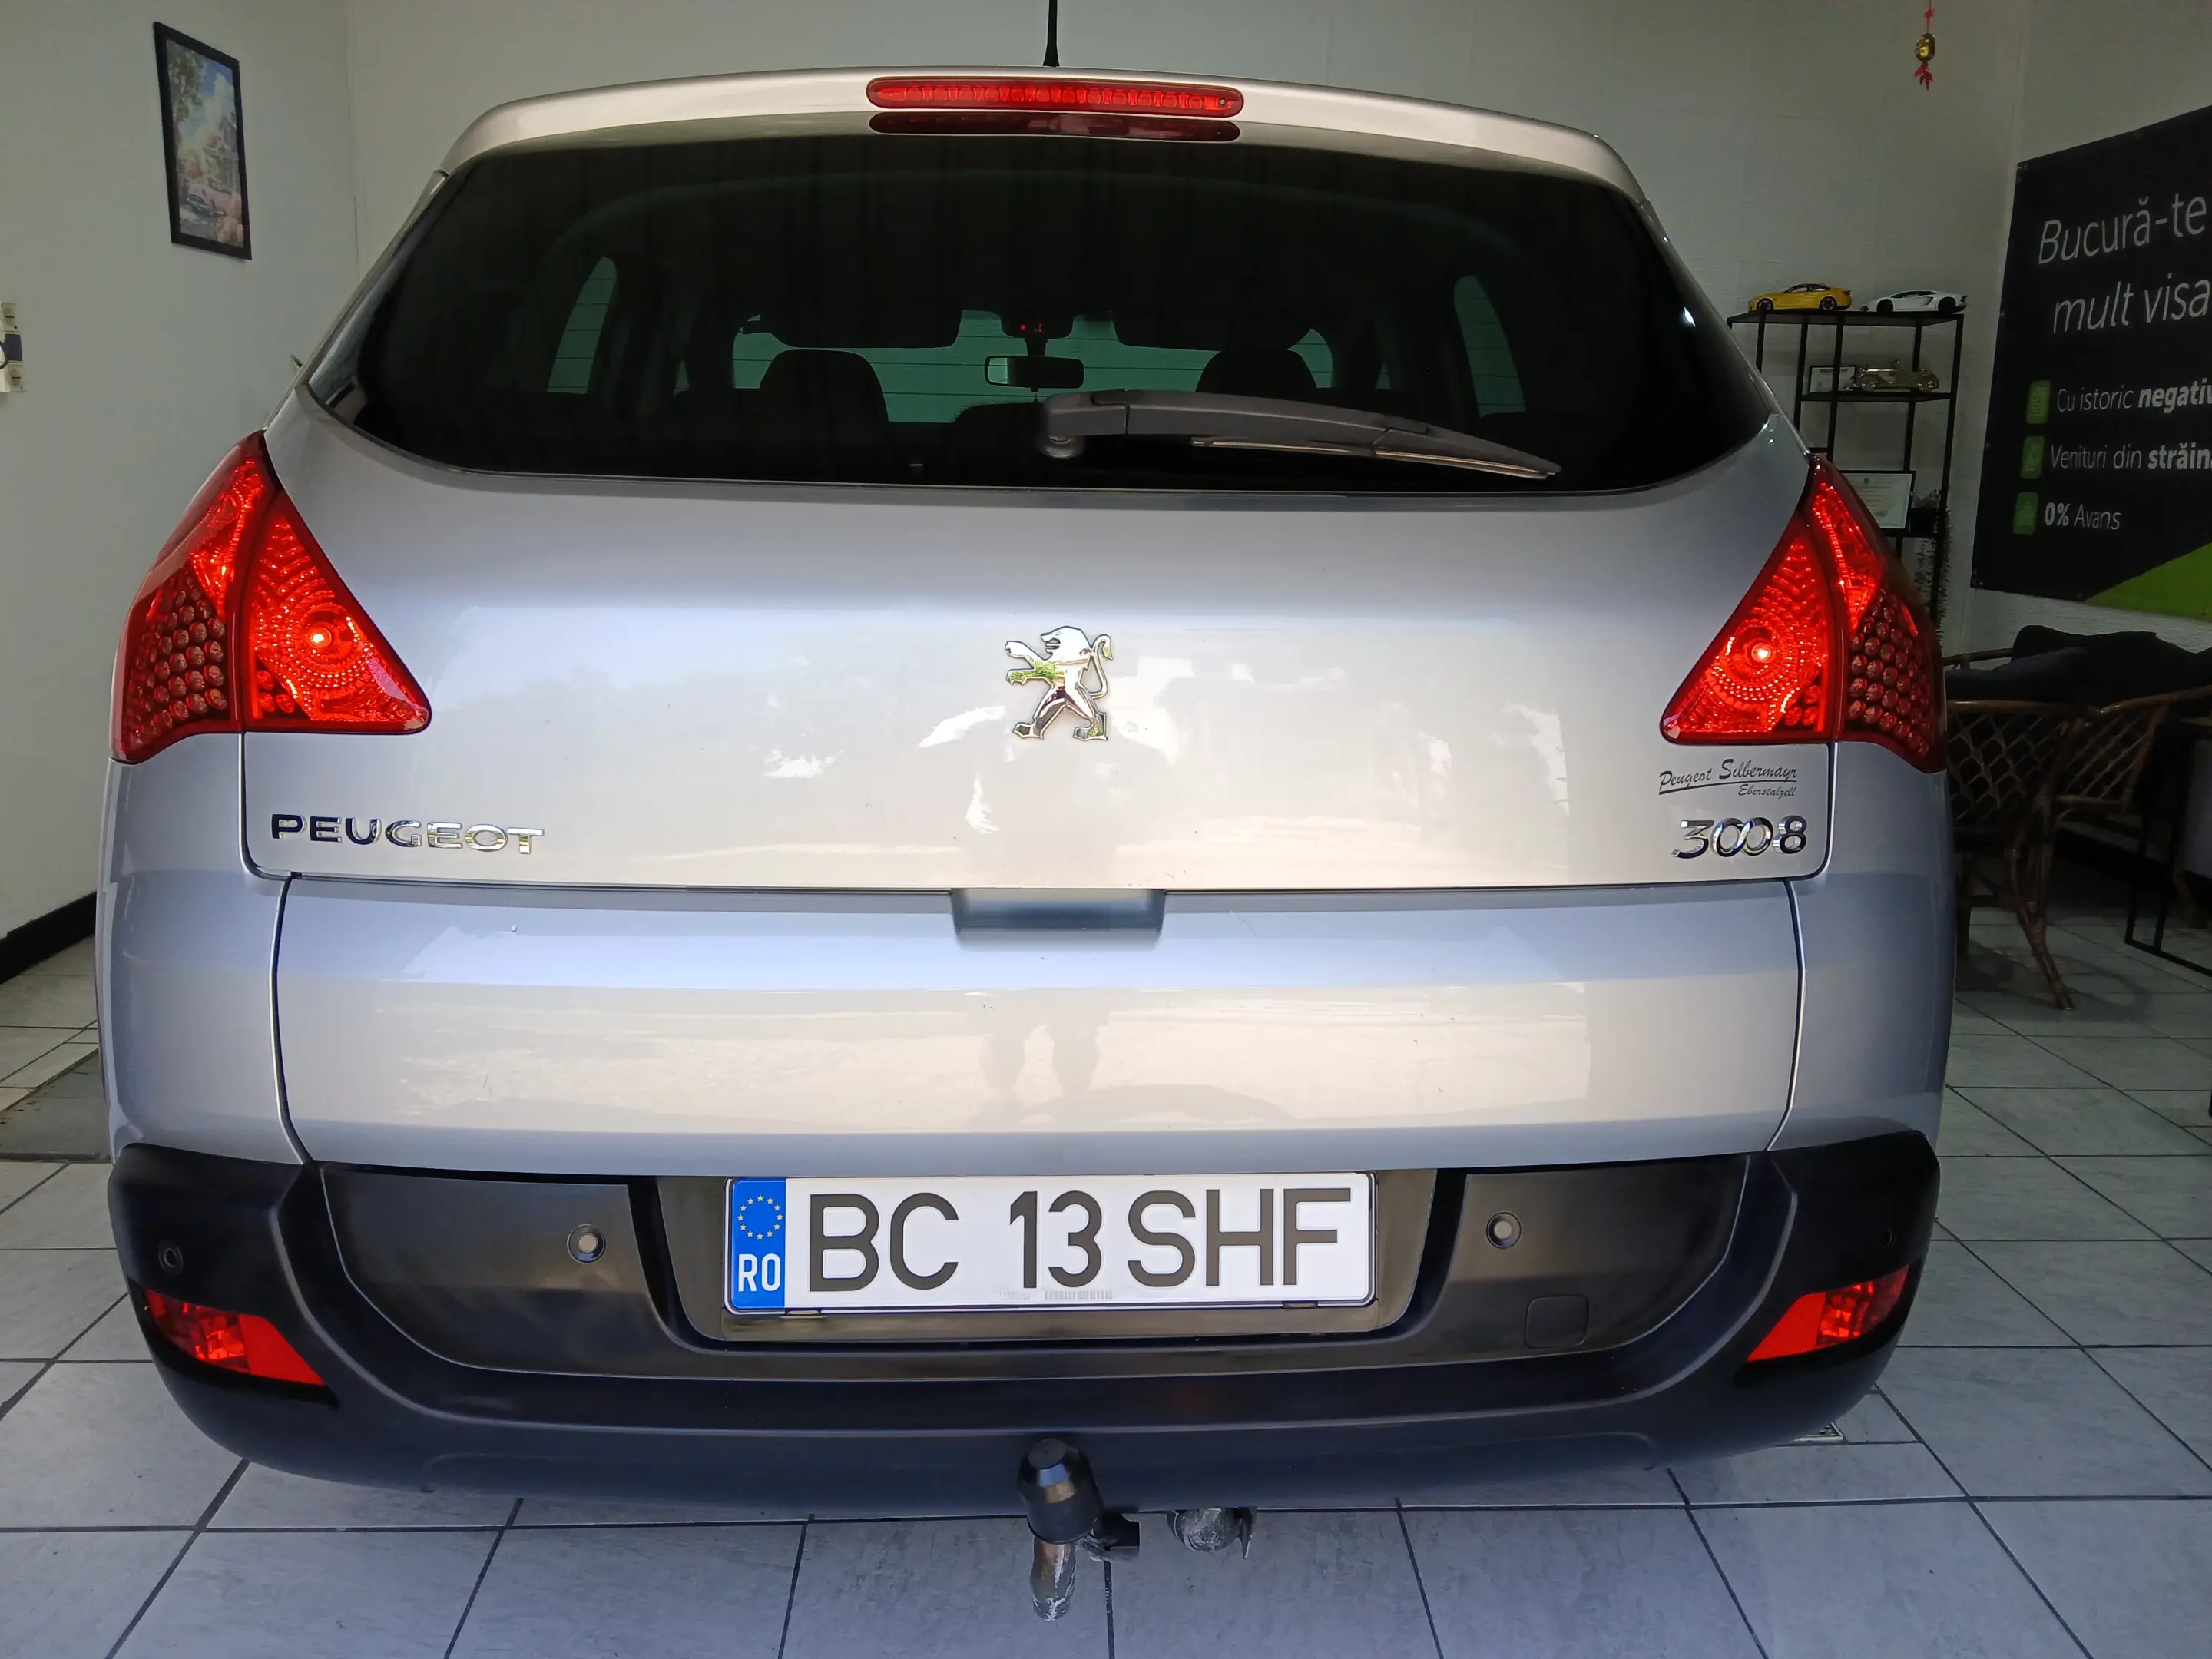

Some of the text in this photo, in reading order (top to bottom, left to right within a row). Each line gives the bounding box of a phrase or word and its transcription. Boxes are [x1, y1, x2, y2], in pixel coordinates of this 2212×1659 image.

[2038, 193, 2207, 263] Bucură-te
[2053, 273, 2210, 333] mult visa
[2057, 389, 2075, 412] Cu
[2079, 385, 2134, 411] istoric
[2051, 442, 2212, 469] Venituri din străin
[2045, 502, 2121, 531] 0% Avans
[1659, 758, 1797, 790] Peugeot Silbermayr
[1737, 783, 1796, 800] Eberstalzell
[271, 813, 545, 855] PEUGEOT
[1671, 815, 1807, 859] 3008
[809, 1187, 1352, 1292] BC 13 SHF
[737, 1253, 781, 1293] RO
